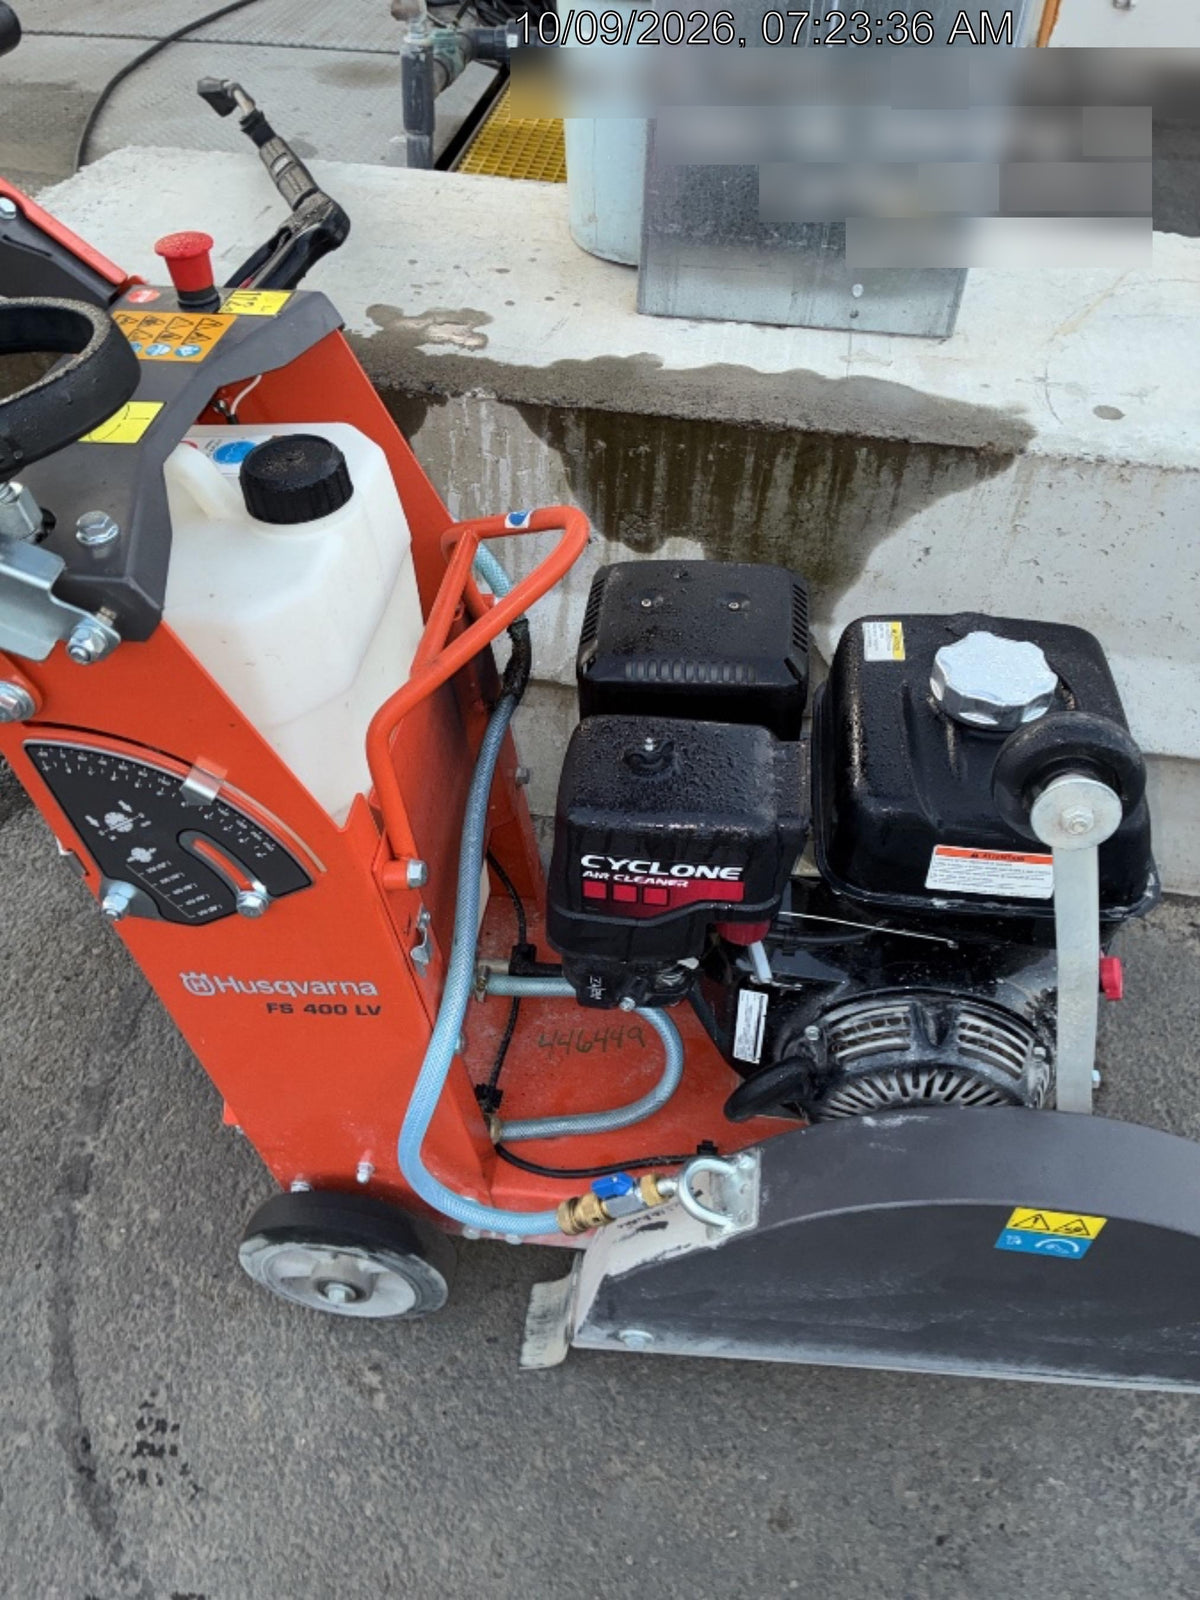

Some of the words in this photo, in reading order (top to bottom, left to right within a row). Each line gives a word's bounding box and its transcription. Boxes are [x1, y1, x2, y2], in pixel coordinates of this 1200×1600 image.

[580, 854, 744, 881] CYCLONE
[582, 870, 610, 880] AIR
[612, 873, 690, 888] CLEANER
[213, 975, 379, 998] Husqvarna
[266, 1002, 294, 1015] FS
[303, 1003, 349, 1016] 400
[355, 1004, 382, 1016] LV
[537, 1025, 646, 1058] 446449
